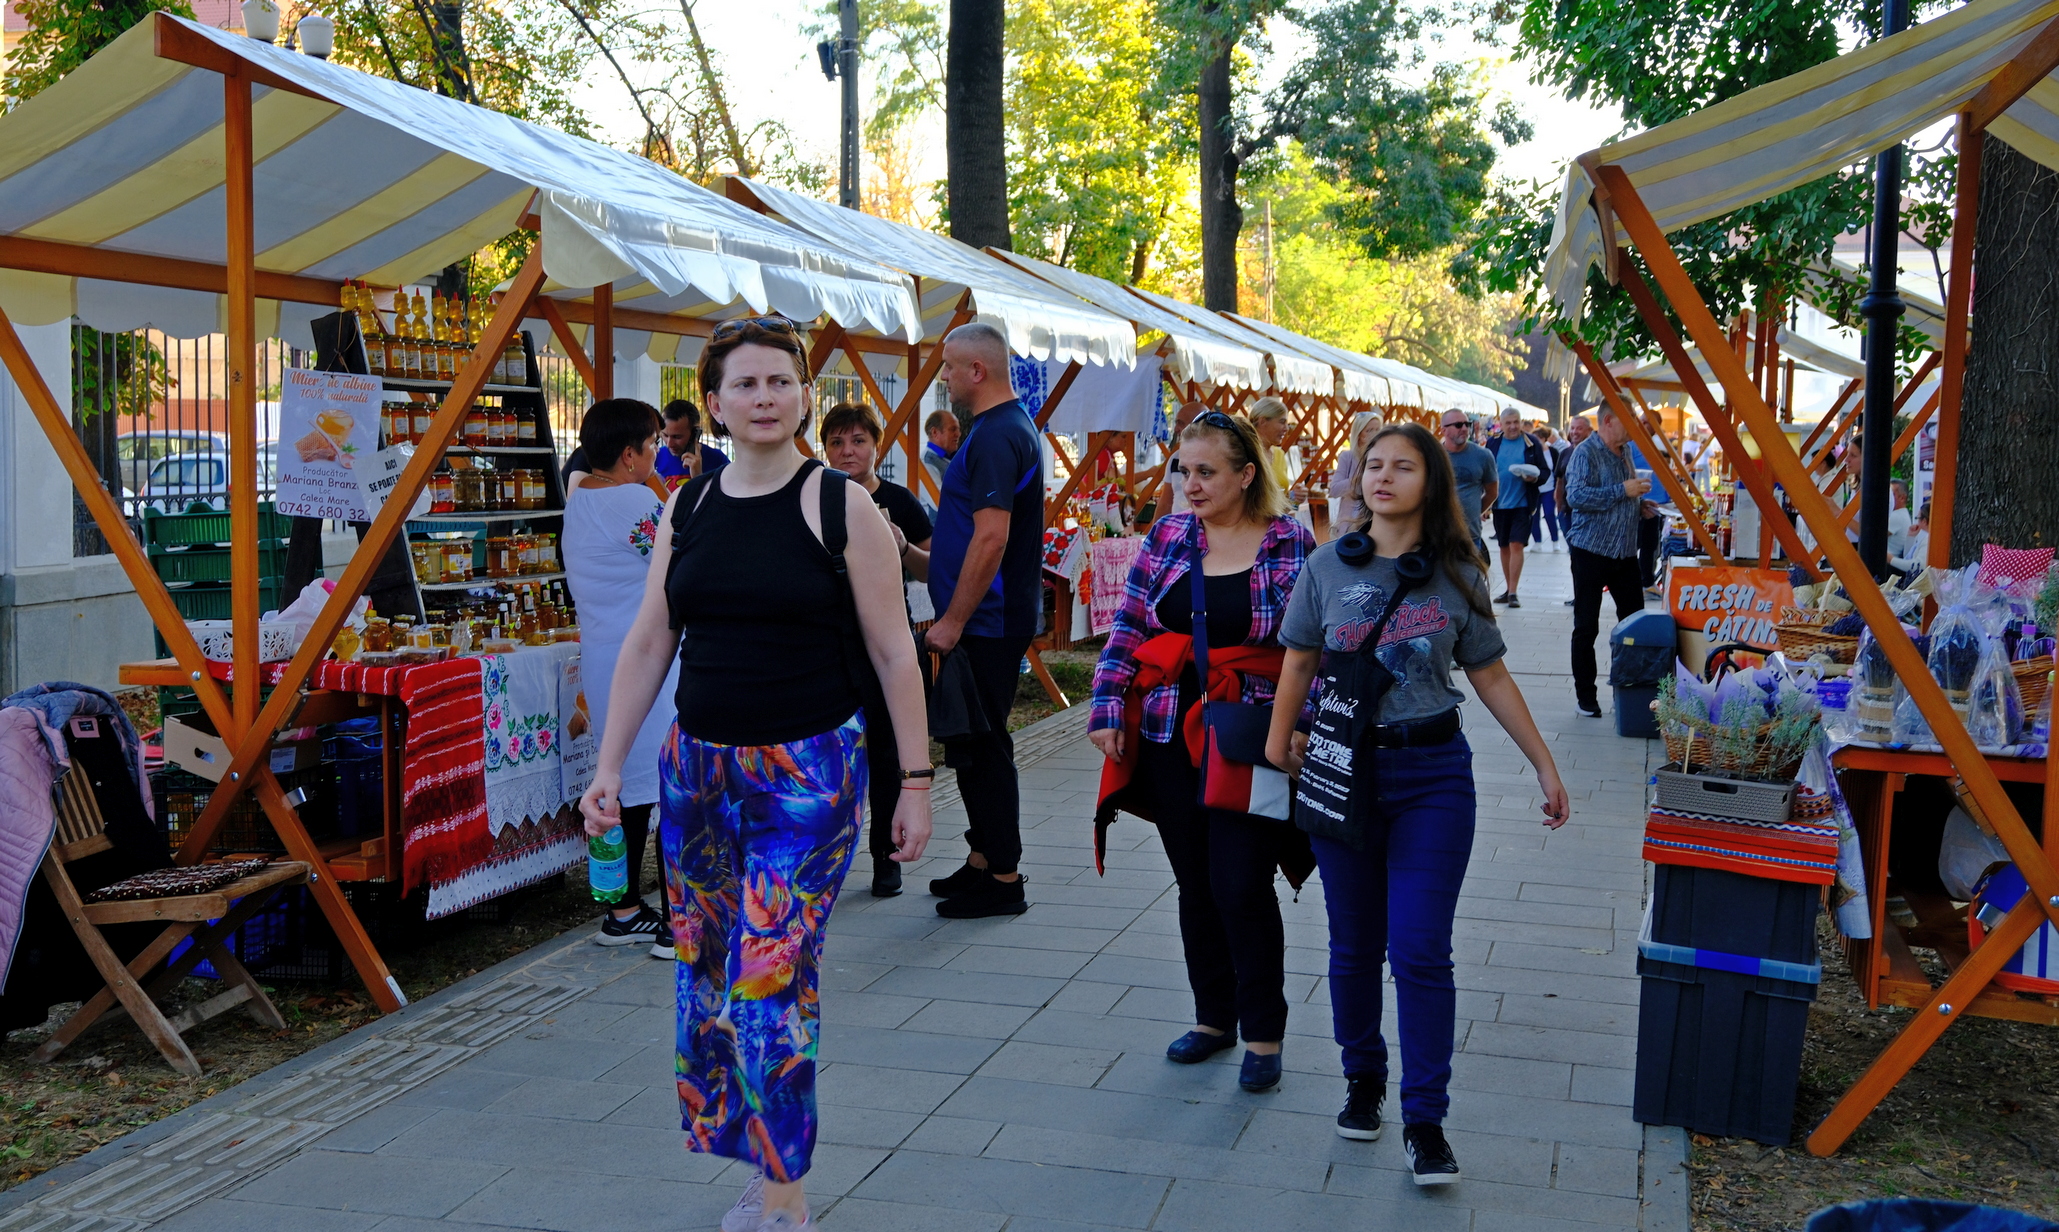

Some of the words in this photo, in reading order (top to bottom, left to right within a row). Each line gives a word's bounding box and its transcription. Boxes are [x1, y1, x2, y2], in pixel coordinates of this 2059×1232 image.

[343, 377, 377, 392] albine
[300, 388, 324, 400] 100%
[302, 466, 348, 478] Producător
[384, 459, 398, 471] AICI
[283, 474, 324, 487] Mariana
[328, 477, 359, 490] Branz
[368, 483, 379, 494] SE
[379, 477, 396, 493] POATE
[319, 487, 332, 496] Loc
[300, 493, 324, 504] Calea
[327, 495, 350, 506] Mare
[279, 501, 311, 516] 0742
[318, 505, 343, 519] 680
[1677, 583, 1756, 611] FRESH
[1755, 599, 1774, 613] DE
[1395, 598, 1441, 636] Rock
[1400, 623, 1440, 638] COMPANY
[1311, 746, 1353, 771] METAL
[568, 782, 583, 796] 0742
